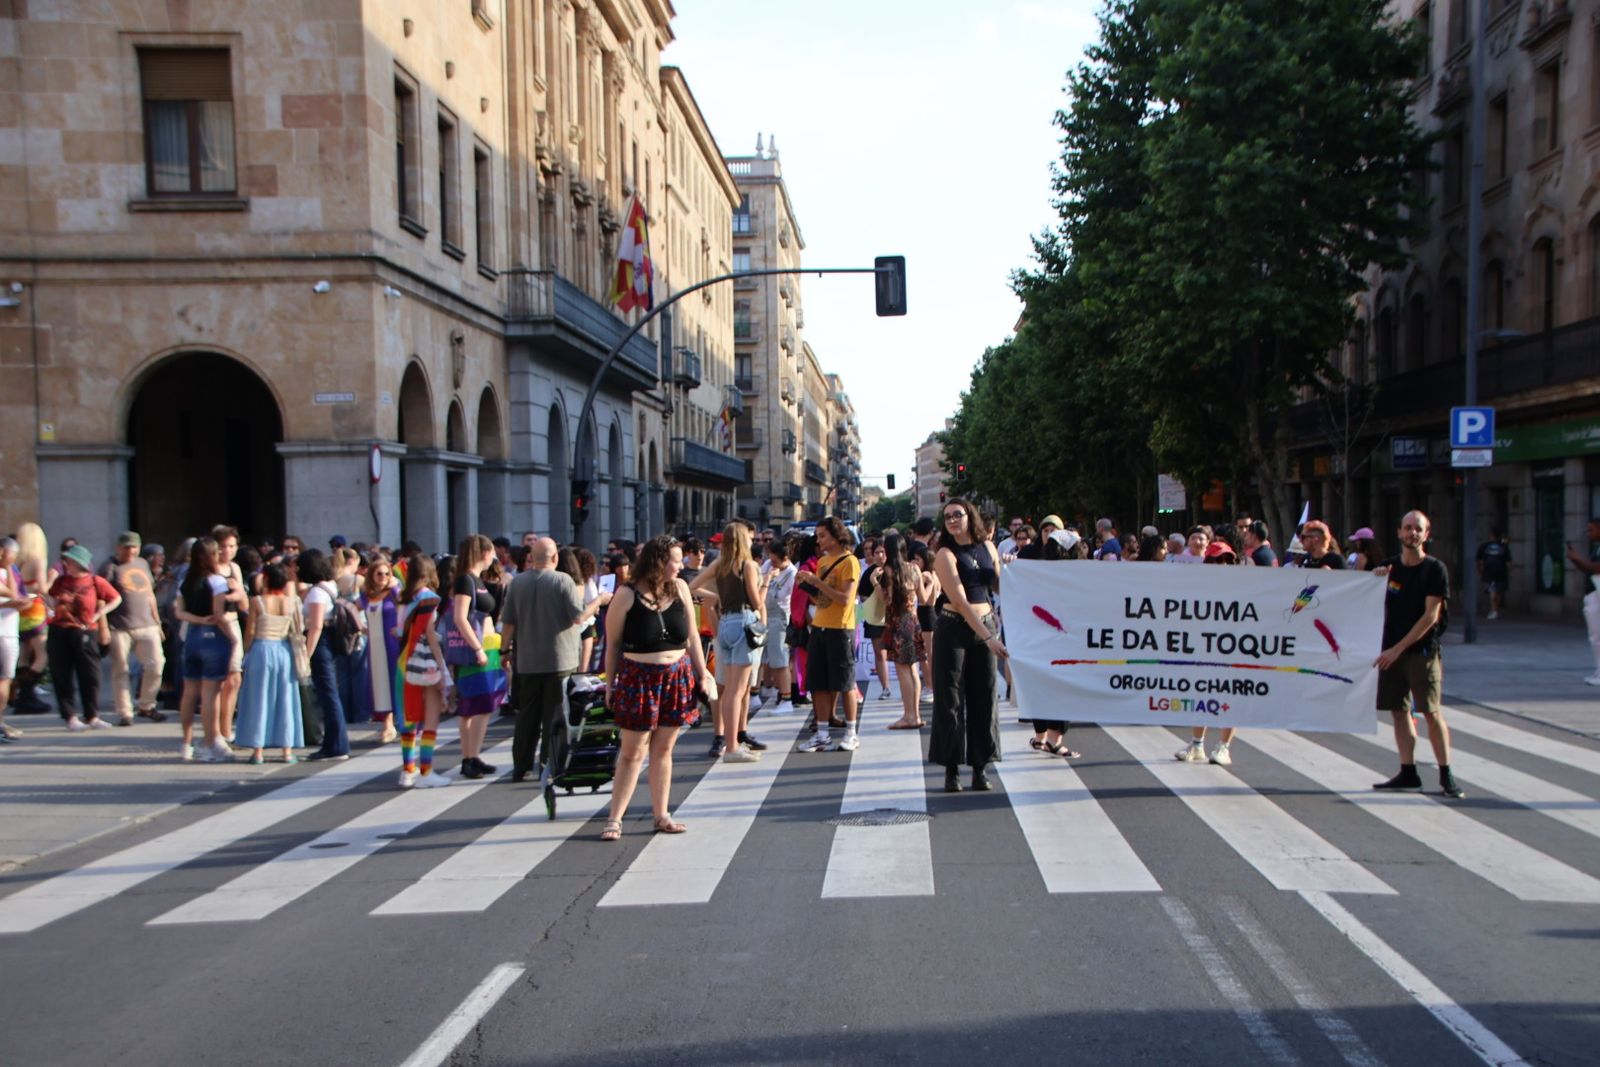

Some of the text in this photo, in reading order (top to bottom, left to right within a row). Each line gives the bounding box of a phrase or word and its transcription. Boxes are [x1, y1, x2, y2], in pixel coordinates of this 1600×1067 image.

[1458, 411, 1487, 443] P
[1125, 597, 1258, 622] LA PLUMA
[1086, 628, 1296, 659] LE DA EL TOQUE
[1109, 674, 1269, 696] ORGULLO CHARRO
[1148, 696, 1230, 715] LGBTIAQ+
